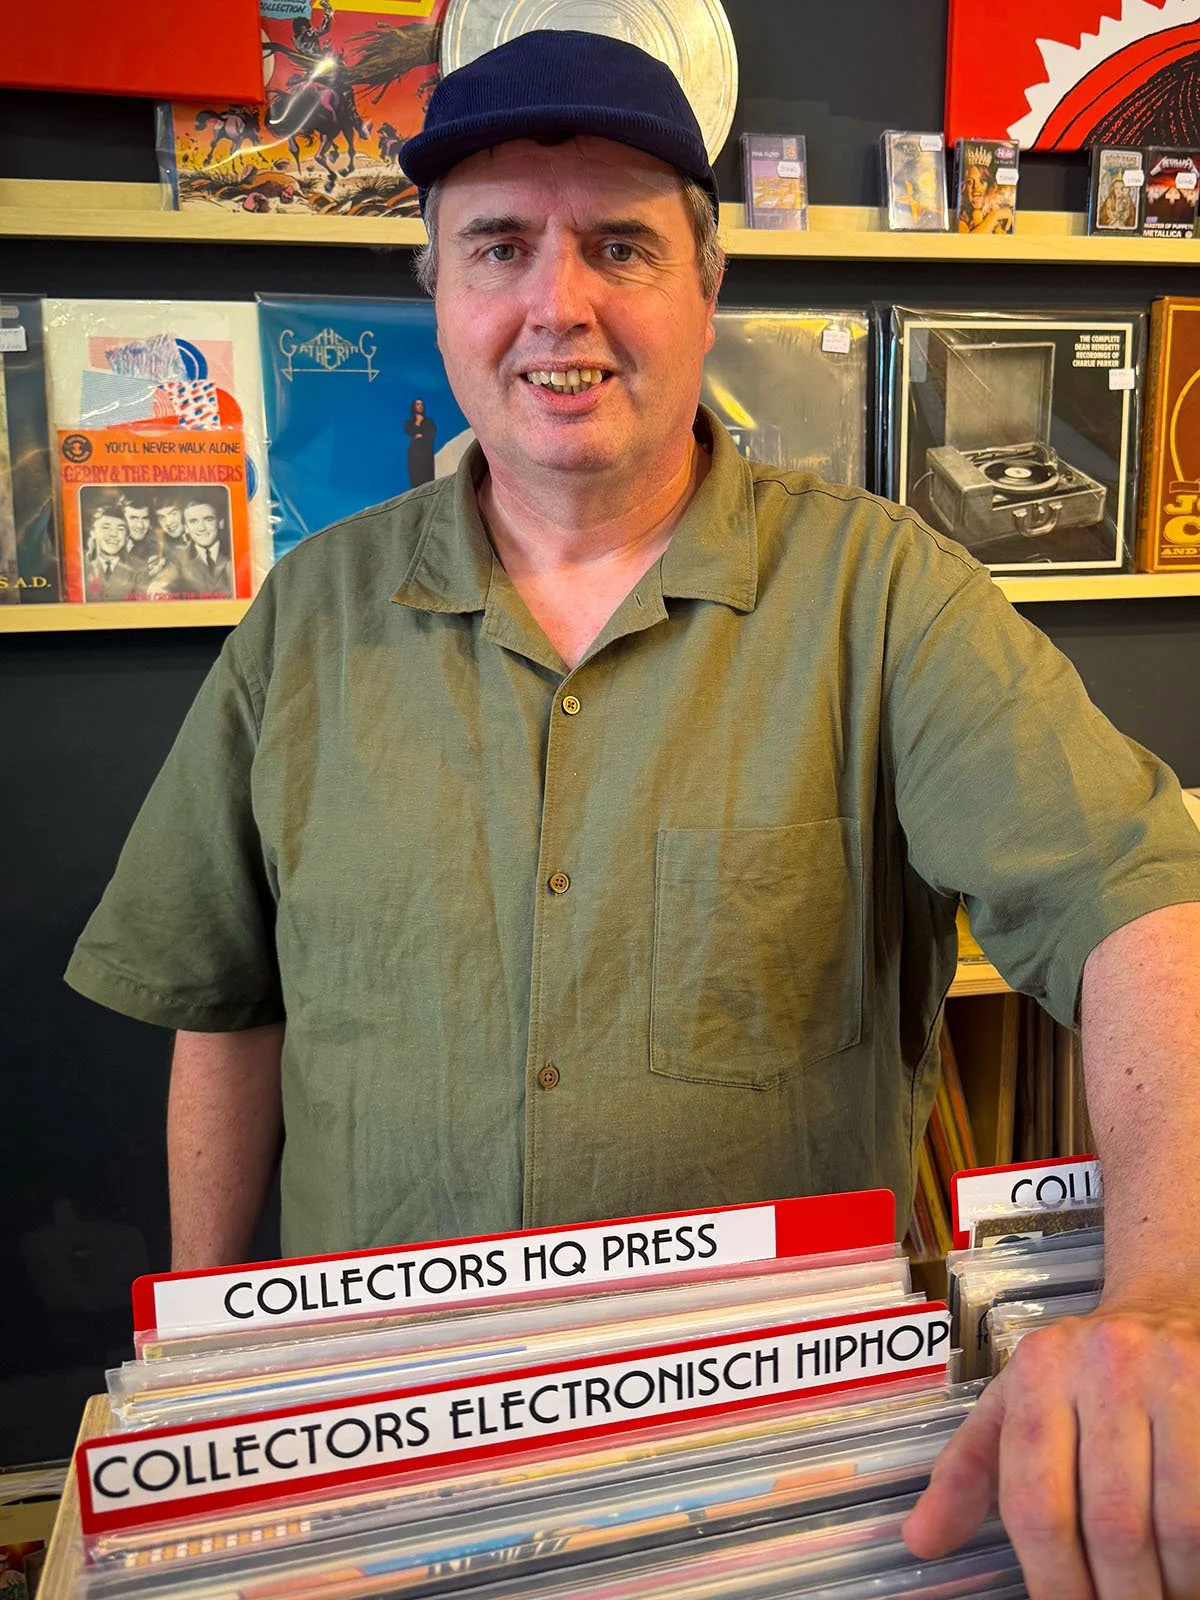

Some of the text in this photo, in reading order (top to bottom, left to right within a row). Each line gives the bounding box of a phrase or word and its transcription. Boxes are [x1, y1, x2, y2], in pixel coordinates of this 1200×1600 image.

[1143, 230, 1182, 238] METALLICA
[1091, 335, 1120, 343] COMPLETE
[1074, 343, 1090, 351] DEAN
[1075, 351, 1111, 359] RECORDINGS
[1072, 359, 1095, 367] CHARLIE
[105, 442, 240, 454] YOU'LL NEVER WALK ALONE
[63, 465, 242, 482] GERRY & THE PACEMAKERS
[1164, 494, 1200, 515] J
[1161, 547, 1198, 555] AND
[14, 576, 51, 588] A.D.
[1011, 1170, 1100, 1210] COLL
[224, 1223, 718, 1320] COLLECTORS HQ PRESS
[93, 1406, 430, 1499] COLLECTORS
[449, 1347, 780, 1440] ELECTRONISCH
[797, 1320, 949, 1379] HIPHOP
